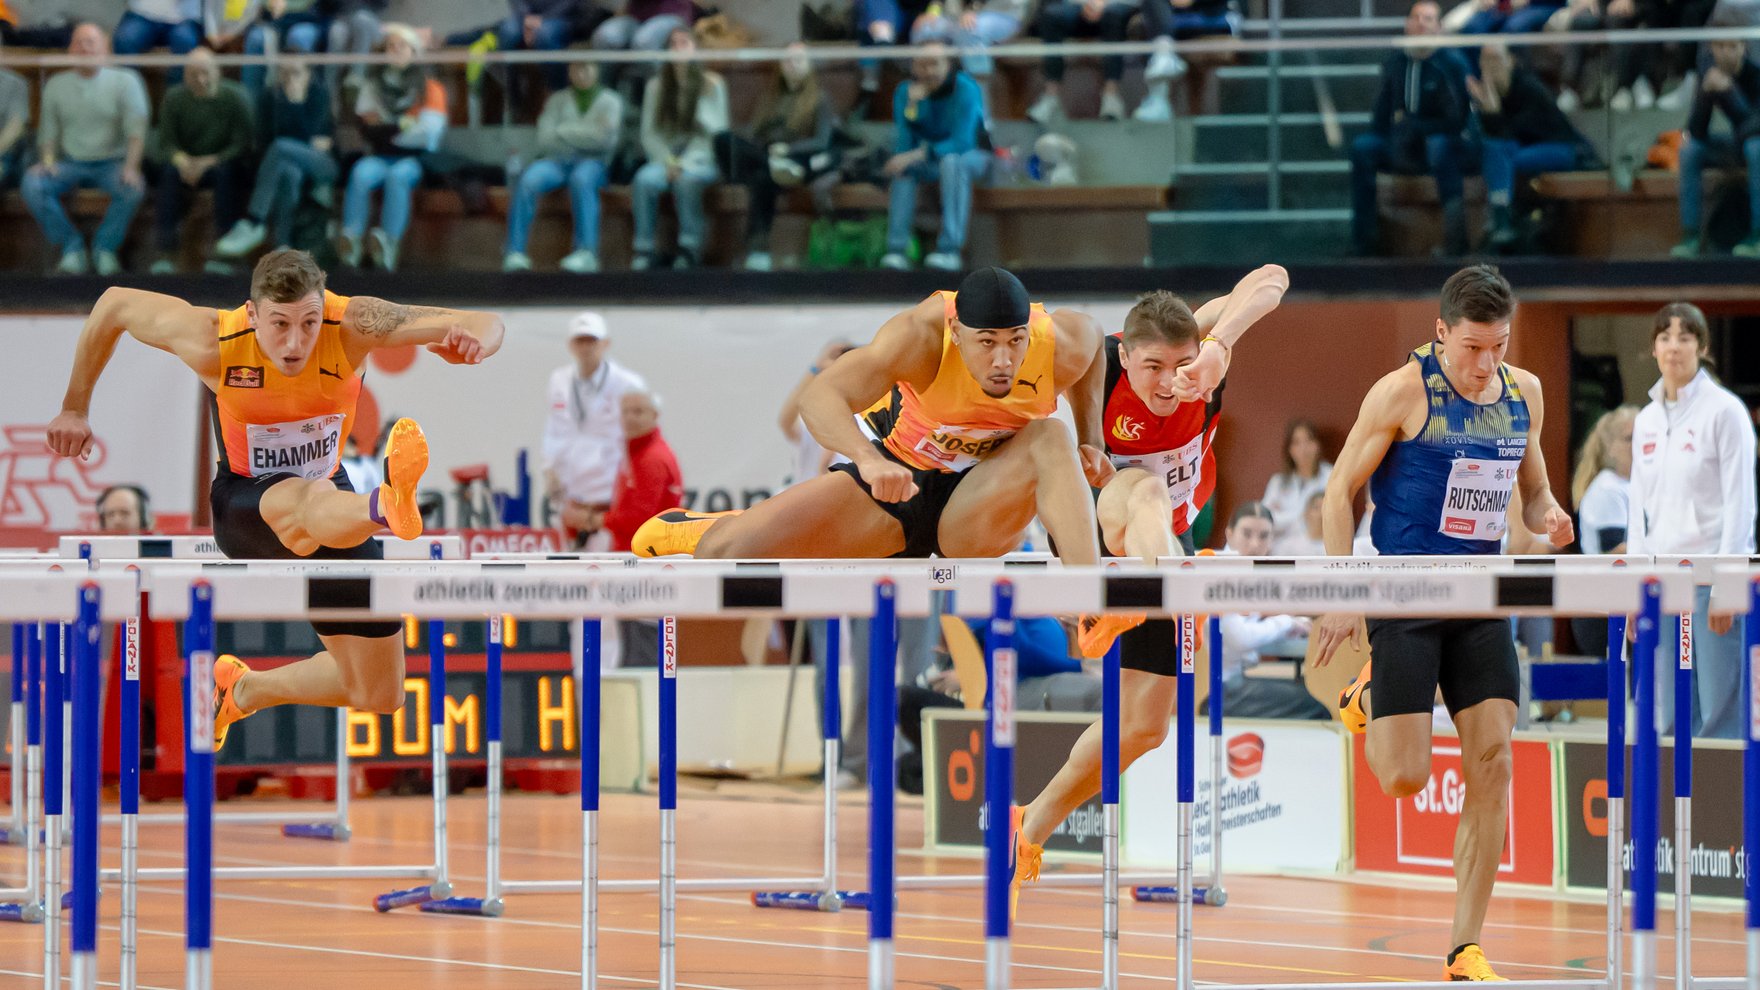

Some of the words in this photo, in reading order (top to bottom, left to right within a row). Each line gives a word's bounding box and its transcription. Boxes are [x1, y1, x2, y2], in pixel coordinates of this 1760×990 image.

[253, 430, 338, 469] EHAMMER
[1164, 456, 1199, 488] ELT
[1447, 486, 1512, 512] RUTSCHMA
[471, 535, 553, 552] OMEGA
[665, 617, 674, 671] POLANIK
[1184, 613, 1192, 666] POLANIK
[1681, 610, 1691, 663] POLANIK
[538, 675, 575, 752] H
